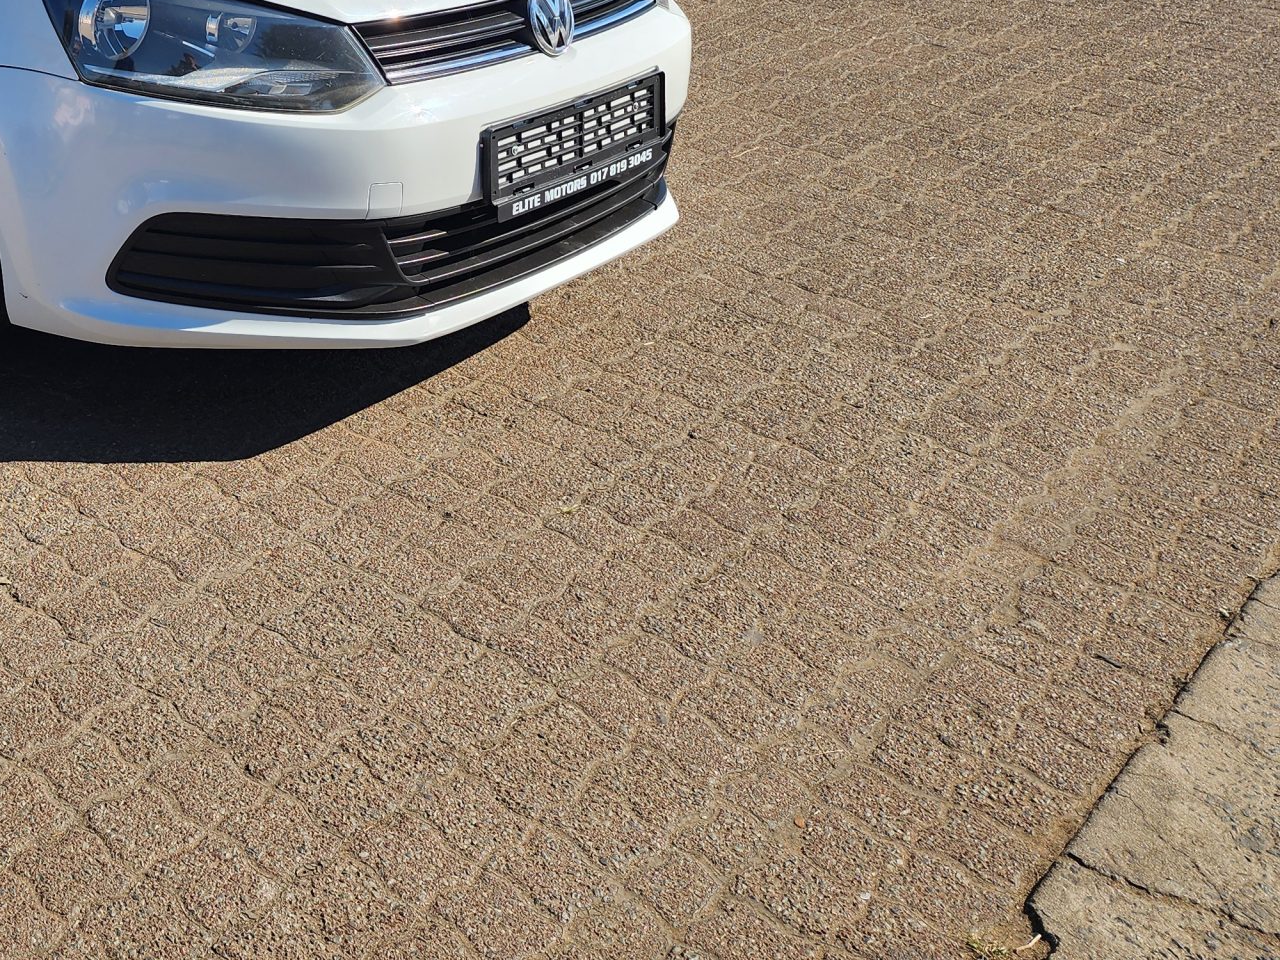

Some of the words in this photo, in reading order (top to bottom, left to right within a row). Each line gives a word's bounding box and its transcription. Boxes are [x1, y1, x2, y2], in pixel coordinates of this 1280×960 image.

[512, 193, 541, 215] ELITE
[544, 175, 587, 203] MOTORS
[589, 169, 608, 185] 017
[609, 159, 627, 177] 819
[628, 148, 653, 168] 3045
